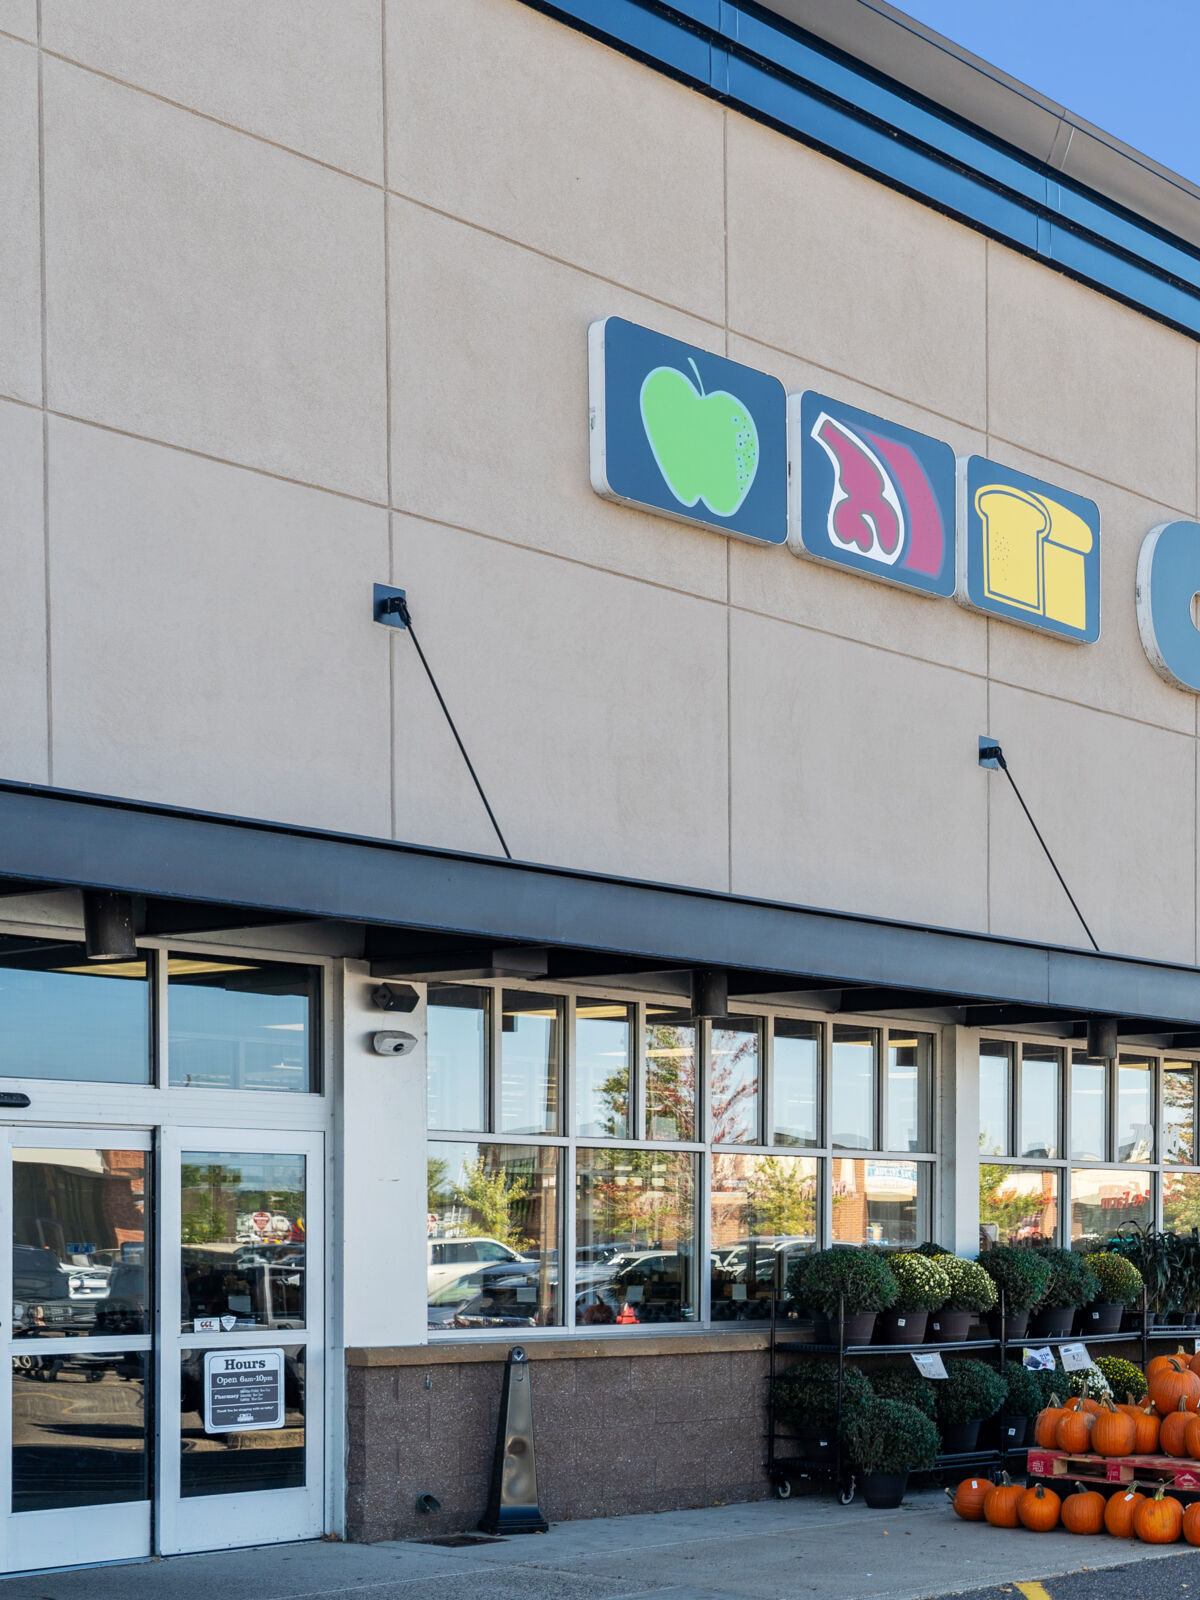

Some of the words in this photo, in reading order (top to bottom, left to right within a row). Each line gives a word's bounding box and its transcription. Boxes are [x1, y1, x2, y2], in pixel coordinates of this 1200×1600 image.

[224, 1359, 266, 1370] Hours
[216, 1376, 238, 1385] Open
[239, 1374, 273, 1383] 6am-10pm
